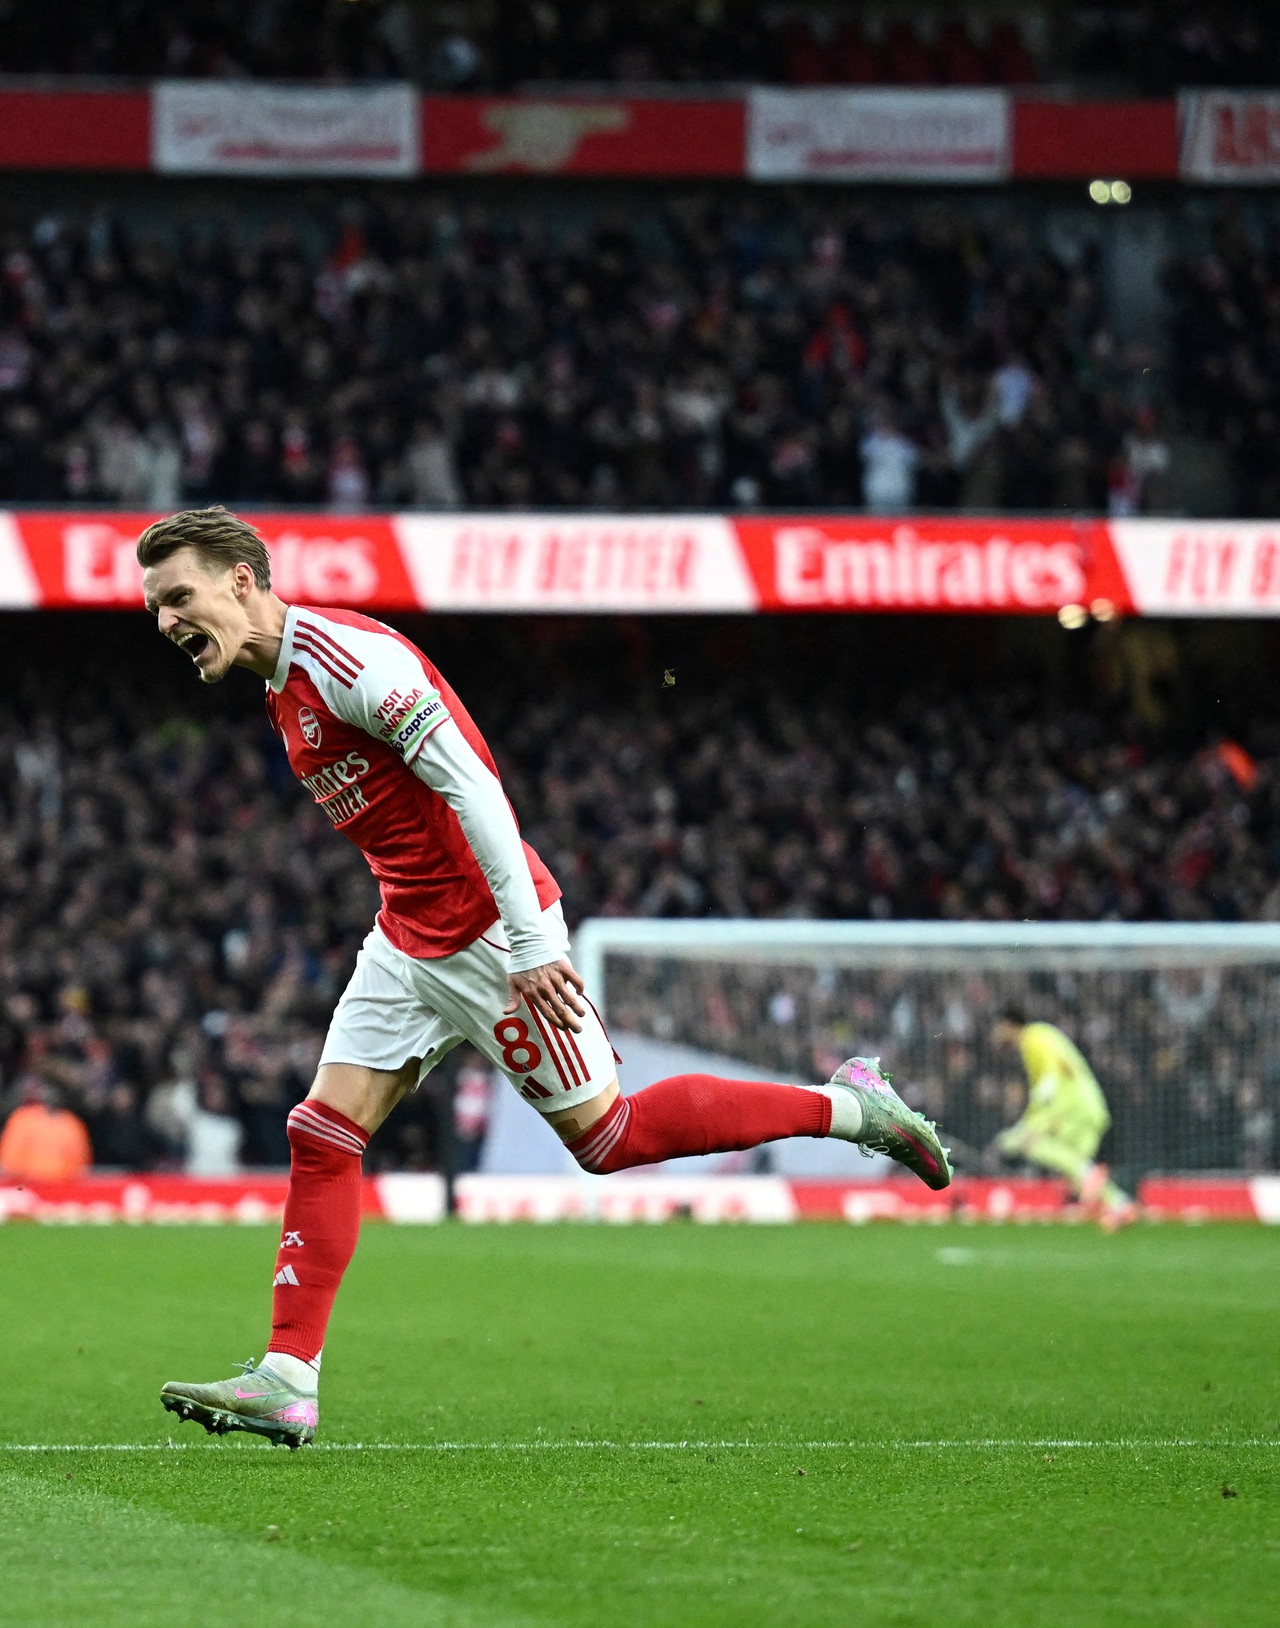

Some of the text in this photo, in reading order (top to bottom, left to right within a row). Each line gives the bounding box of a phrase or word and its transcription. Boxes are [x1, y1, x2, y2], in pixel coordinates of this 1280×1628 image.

[449, 527, 696, 594] FLY BETTER
[774, 526, 1086, 606] Emirates
[373, 688, 402, 721] VISIT
[398, 702, 442, 742] Captain
[493, 1017, 542, 1073] 8
